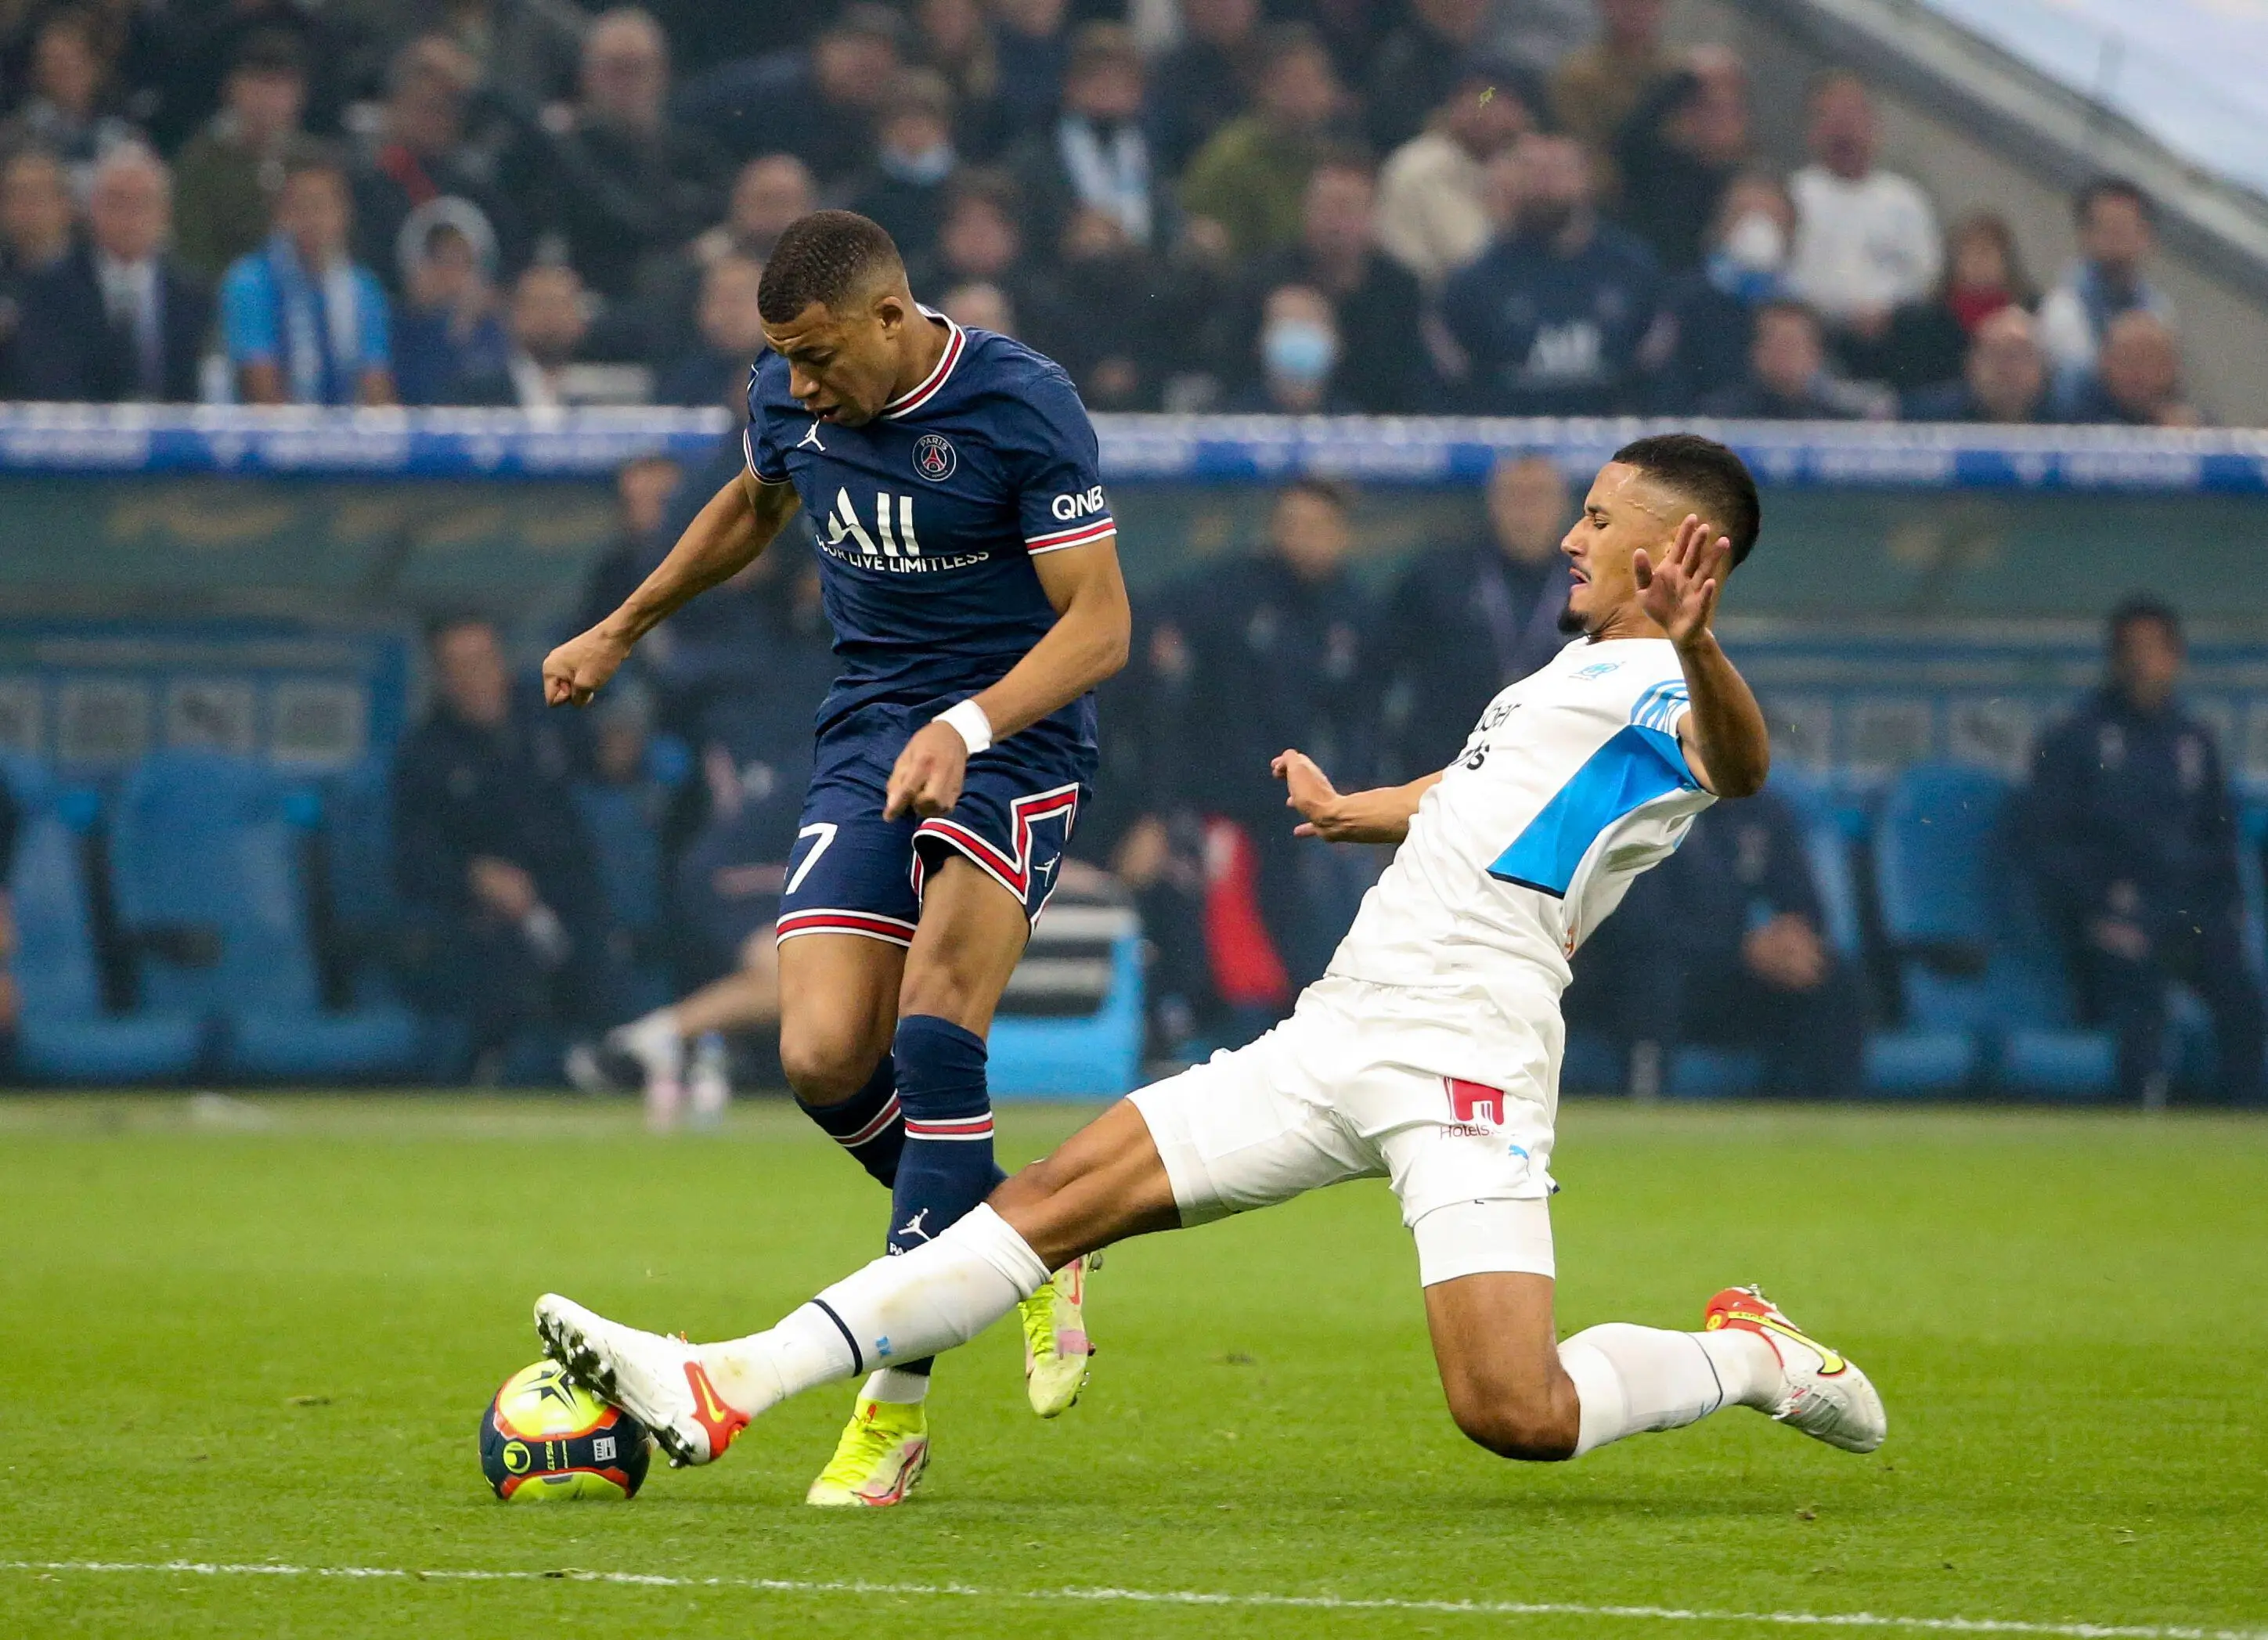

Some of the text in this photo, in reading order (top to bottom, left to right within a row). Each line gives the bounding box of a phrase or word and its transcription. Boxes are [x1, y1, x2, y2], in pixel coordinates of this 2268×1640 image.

[919, 437, 949, 452] PARIS
[1051, 485, 1105, 521] QNB
[848, 550, 885, 571] LIVE
[889, 551, 990, 574] LIMITLESS
[785, 821, 838, 896] 7
